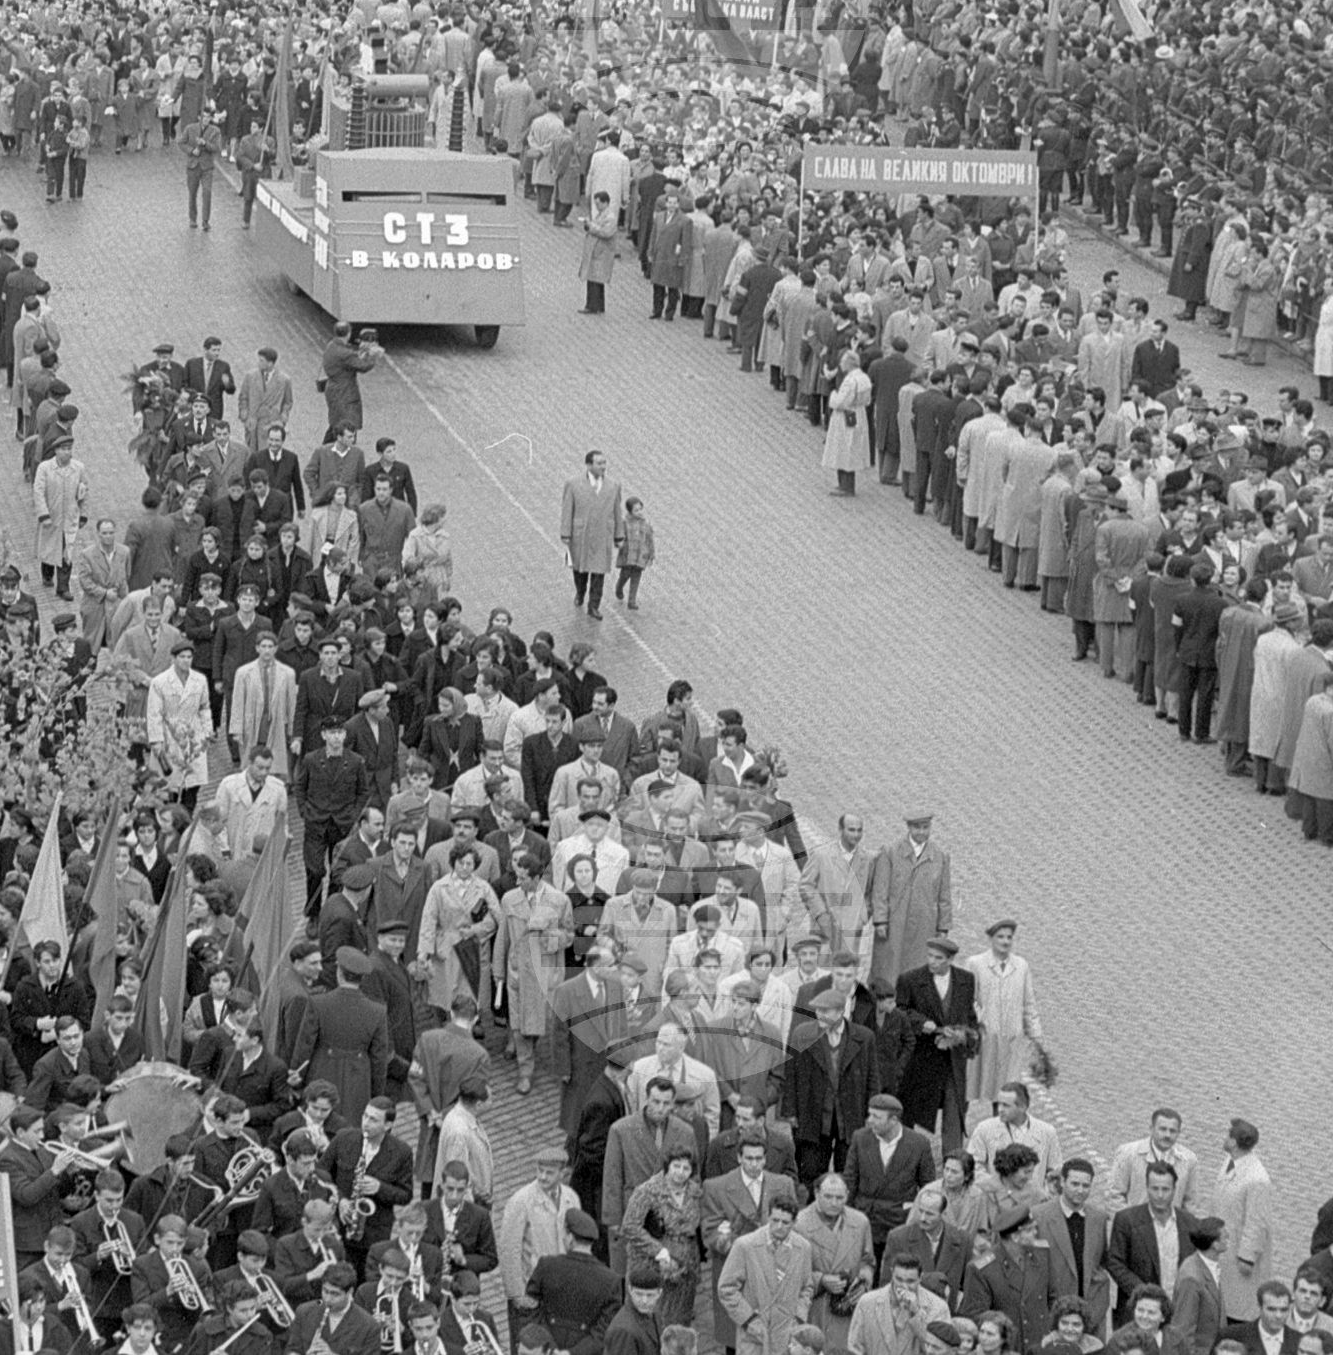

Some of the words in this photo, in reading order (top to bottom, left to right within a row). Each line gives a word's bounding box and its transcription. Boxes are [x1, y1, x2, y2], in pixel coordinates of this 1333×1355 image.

[739, 4, 774, 22] ВЛАСТ
[814, 156, 858, 180] СЛАВА
[860, 158, 877, 181] НА
[882, 158, 948, 183] ВЕЛИКИЯ
[952, 160, 1034, 186] ОКТОМВРИ!
[383, 212, 469, 246] СТЗ
[382, 250, 513, 271] КОЛАРОВ
